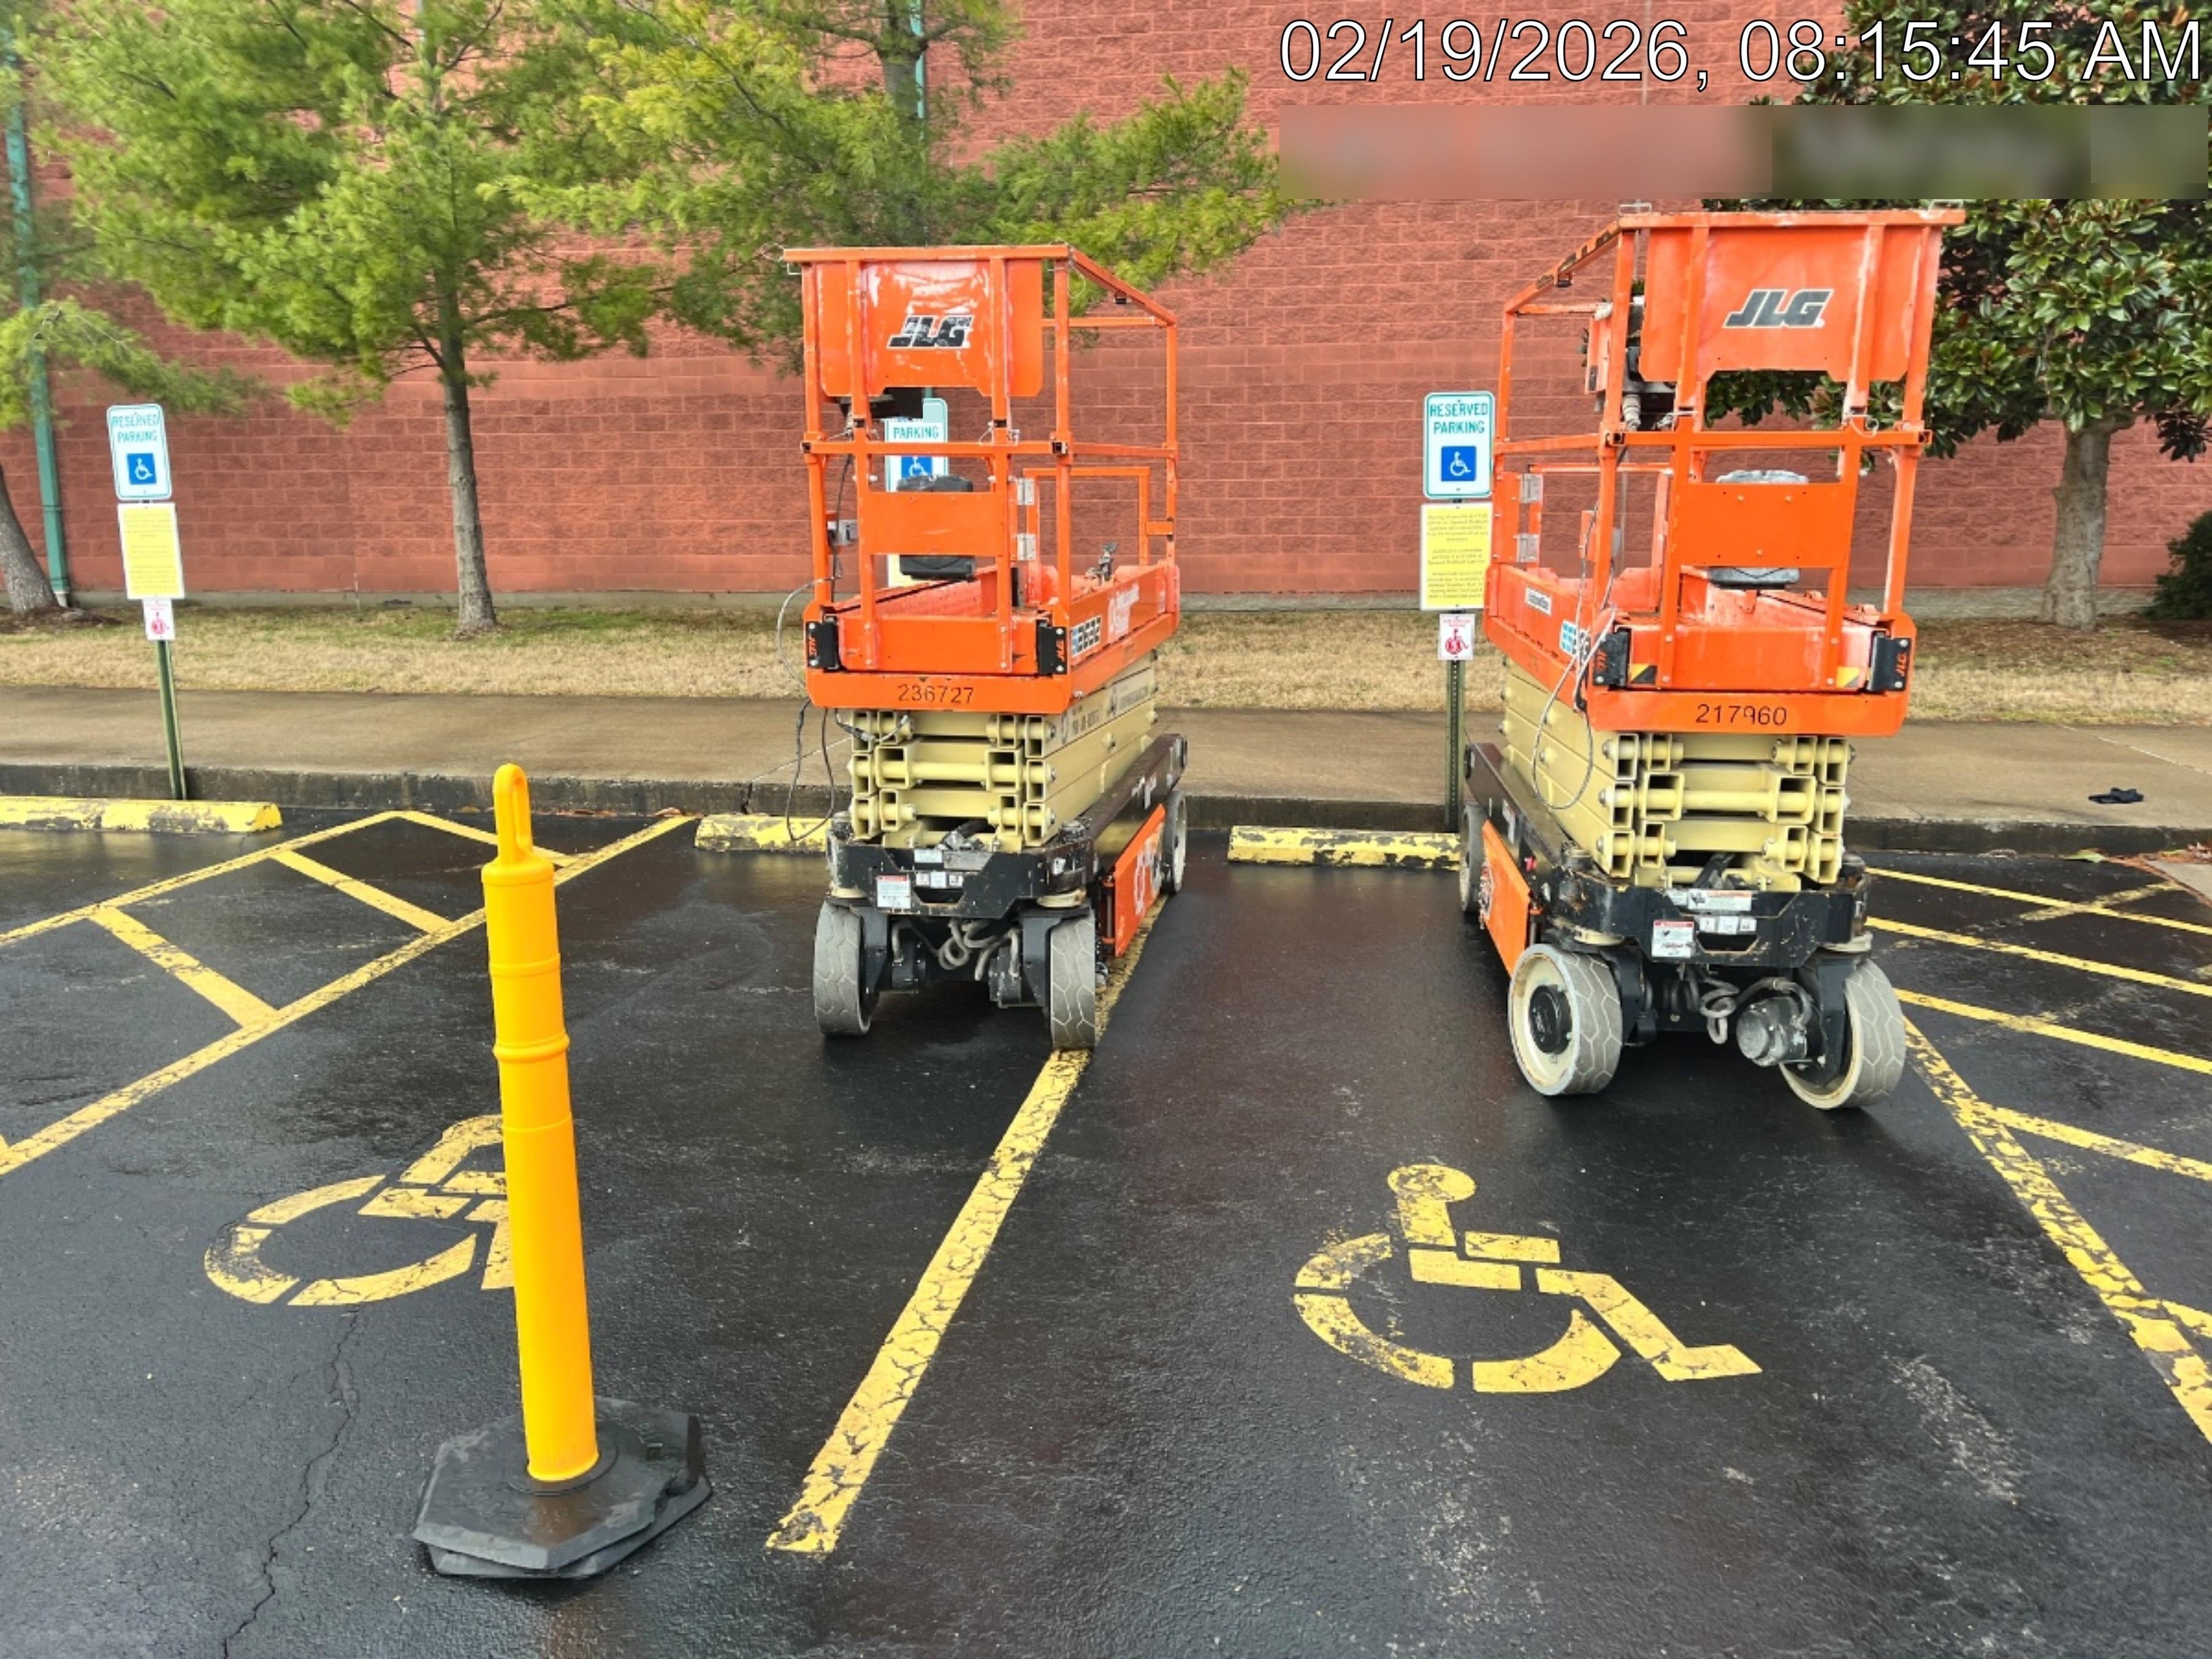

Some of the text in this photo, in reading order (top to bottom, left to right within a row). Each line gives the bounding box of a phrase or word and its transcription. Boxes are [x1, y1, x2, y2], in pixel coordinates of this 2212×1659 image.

[1722, 289, 1835, 329] JLG
[887, 315, 975, 349] JLG
[1429, 402, 1488, 417] RESERVED
[893, 425, 939, 440] PARKING
[1433, 420, 1485, 434] PARKING
[1895, 652, 1907, 677] JLG
[897, 683, 974, 704] 236727
[1695, 703, 1787, 726] 217960
